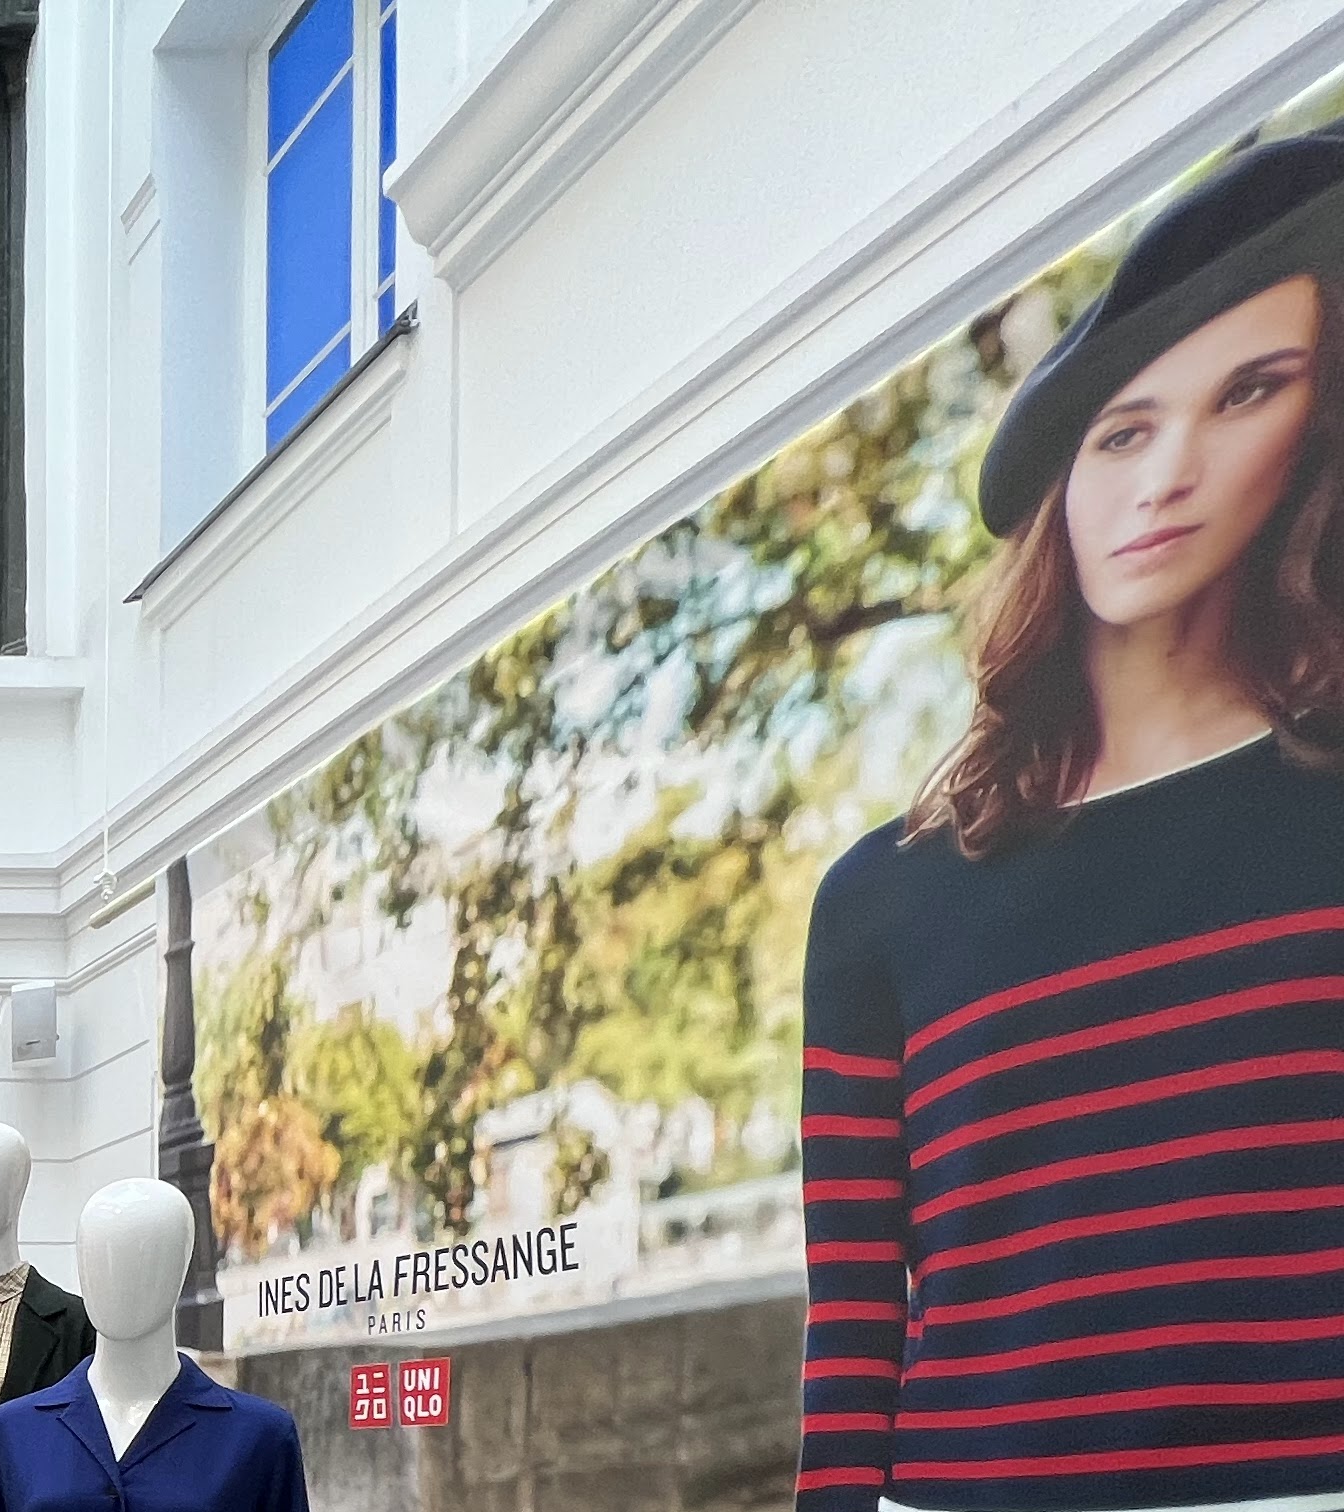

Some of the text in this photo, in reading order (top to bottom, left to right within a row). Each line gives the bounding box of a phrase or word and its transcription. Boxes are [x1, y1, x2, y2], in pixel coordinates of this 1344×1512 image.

[259, 1222, 579, 1317] INES DE LA FRESSANGE
[367, 1308, 427, 1336] PARIS
